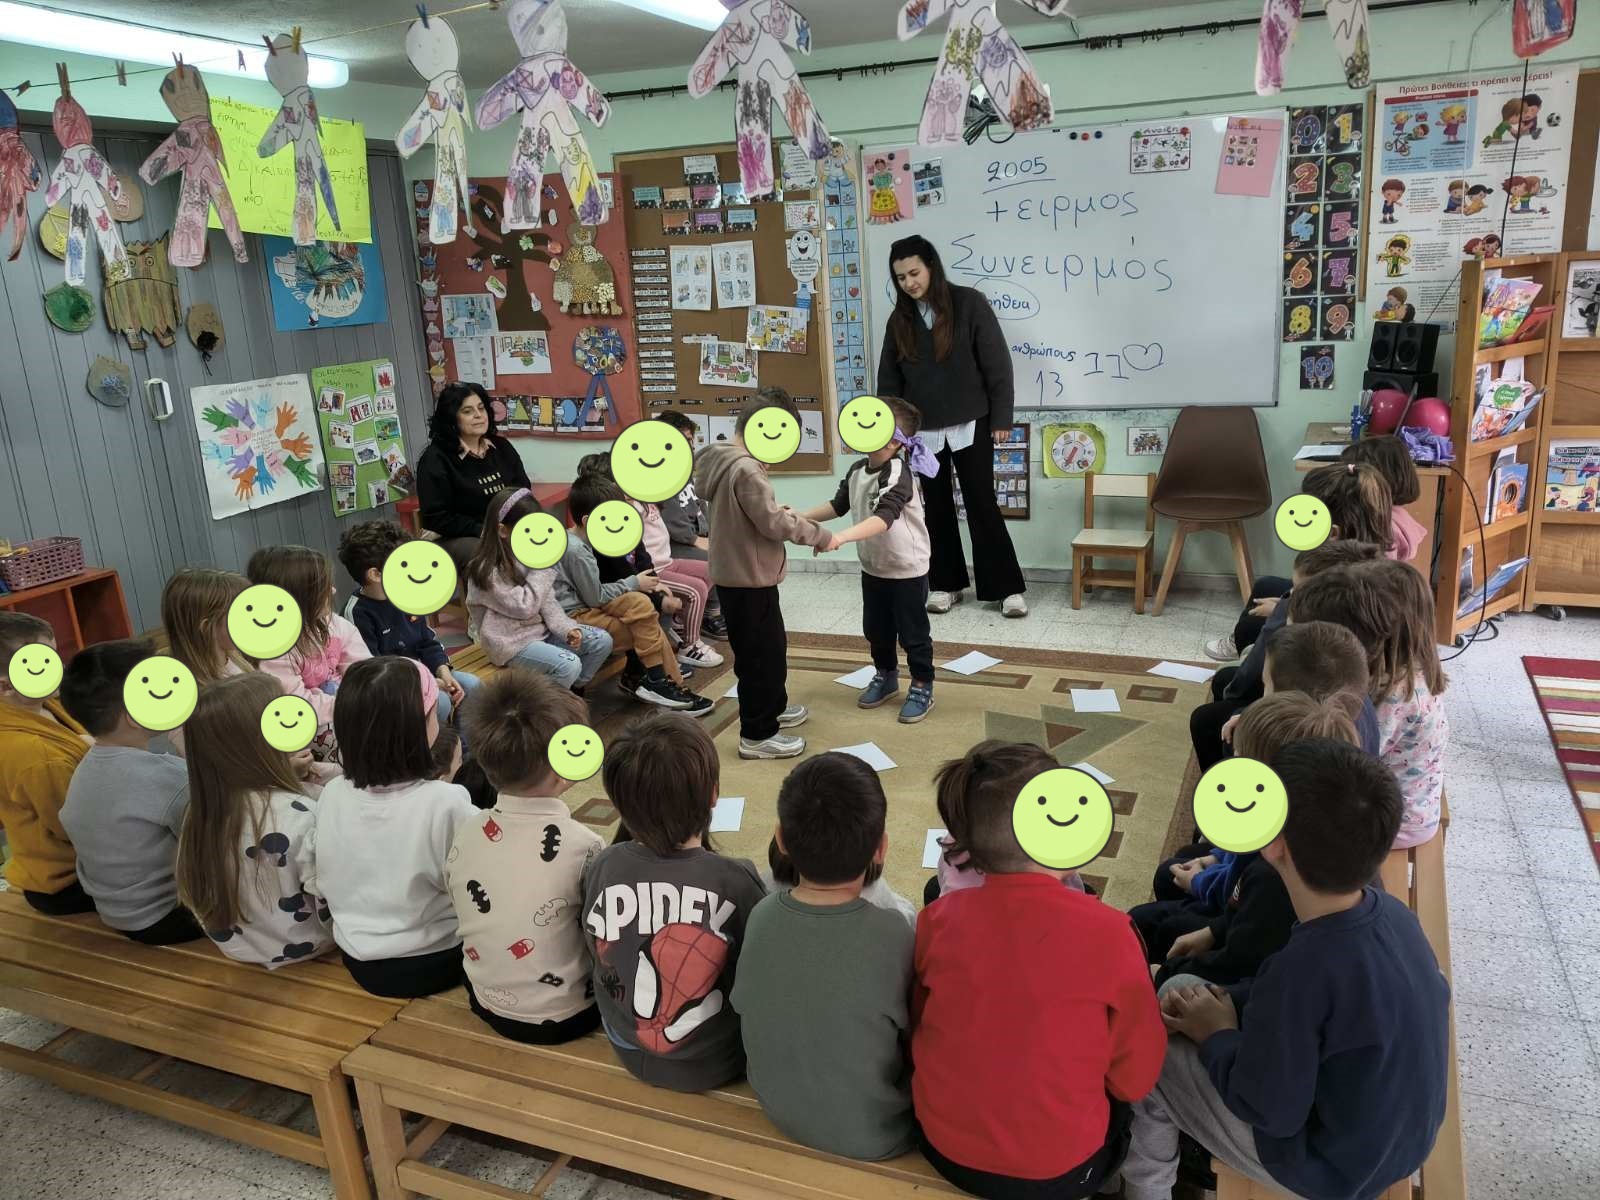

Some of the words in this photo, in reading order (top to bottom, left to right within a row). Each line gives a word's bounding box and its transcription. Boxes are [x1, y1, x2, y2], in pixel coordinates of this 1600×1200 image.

[1295, 114, 1320, 146] 0
[1334, 112, 1353, 144] 1
[987, 156, 1048, 182] 2005
[1294, 162, 1319, 194] 2
[1330, 161, 1354, 193] 3
[1290, 211, 1315, 242] 4
[1329, 211, 1352, 242] 5
[951, 233, 1173, 297] Συνειρμός
[1289, 257, 1312, 289] 6
[1328, 256, 1350, 288] 7
[1289, 304, 1312, 335] 8
[1326, 303, 1350, 335] 9
[1301, 355, 1334, 379] 10
[586, 881, 737, 942] SPIDEY
